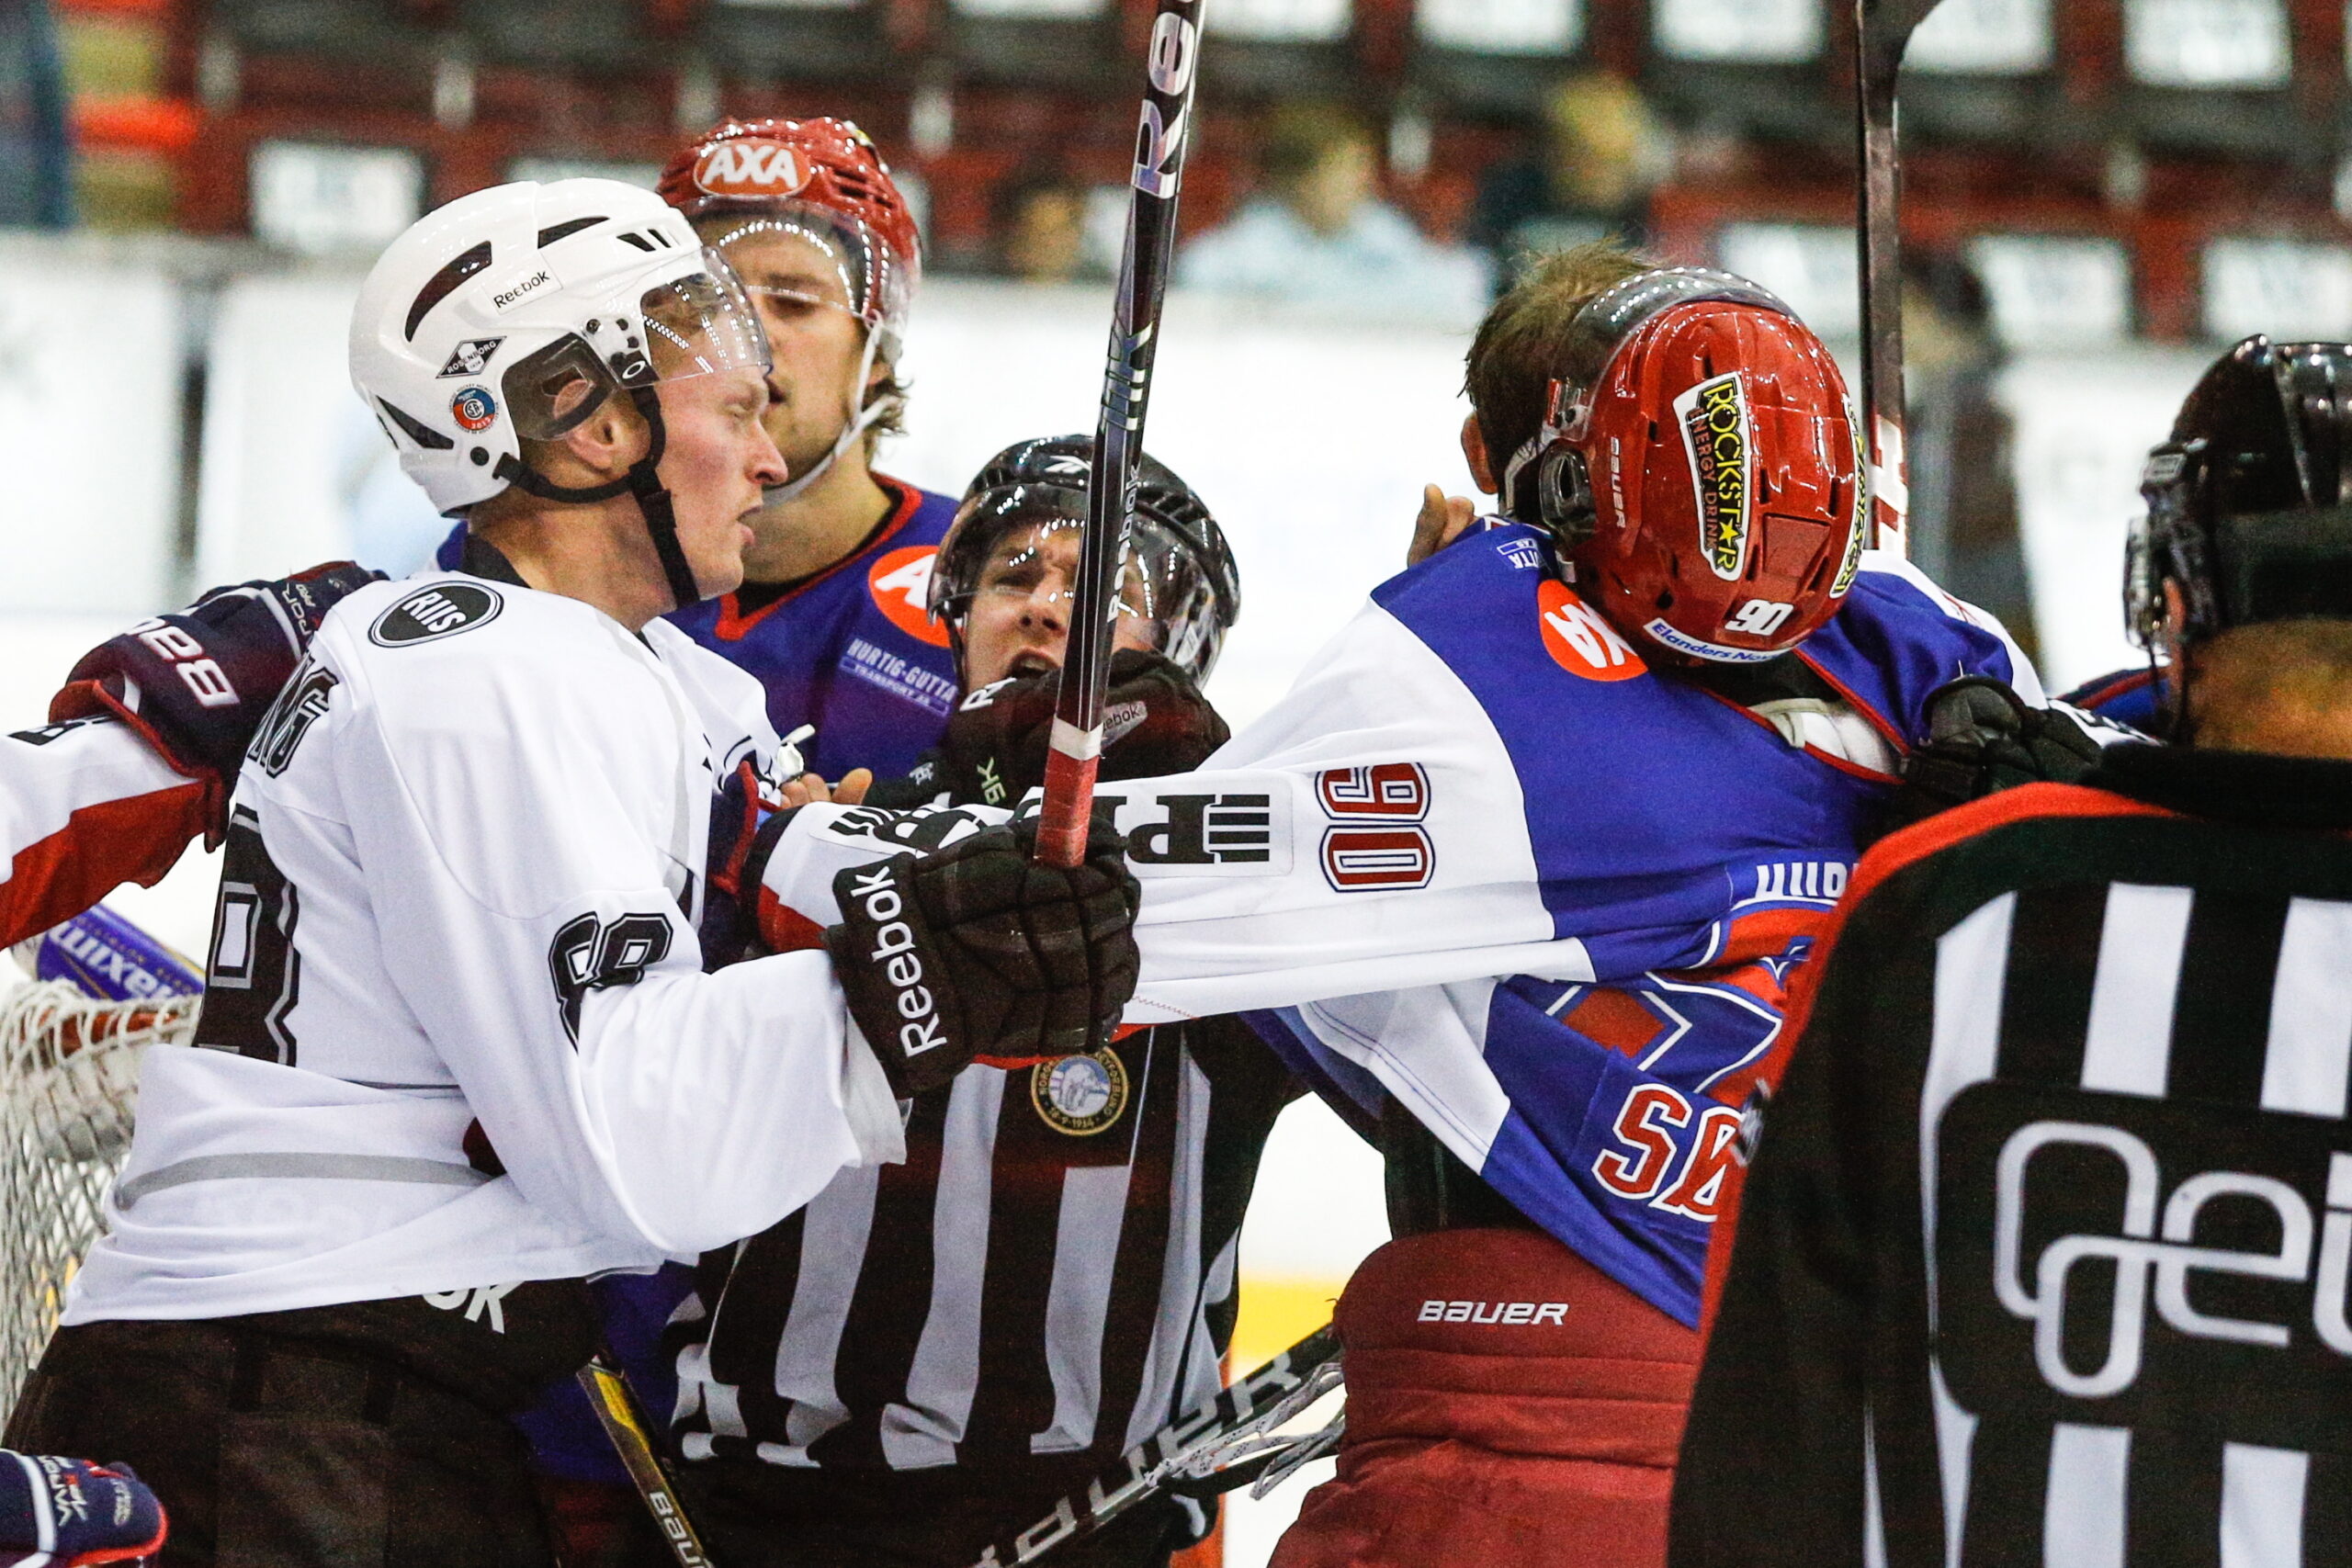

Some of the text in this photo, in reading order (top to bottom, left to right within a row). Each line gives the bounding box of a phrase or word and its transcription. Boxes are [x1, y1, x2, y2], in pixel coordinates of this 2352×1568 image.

[1132, 0, 1195, 199] Re
[701, 144, 797, 186] AXA
[493, 271, 549, 308] Reebok
[1107, 465, 1140, 623] Reebok
[401, 592, 467, 633] RIIS
[1724, 599, 1794, 636] 90
[1651, 622, 1732, 659] Elanders
[1102, 704, 1141, 732] ebok
[851, 865, 947, 1057] Reebok
[1418, 1300, 1569, 1325] BAUER
[649, 1491, 716, 1568] BAU
